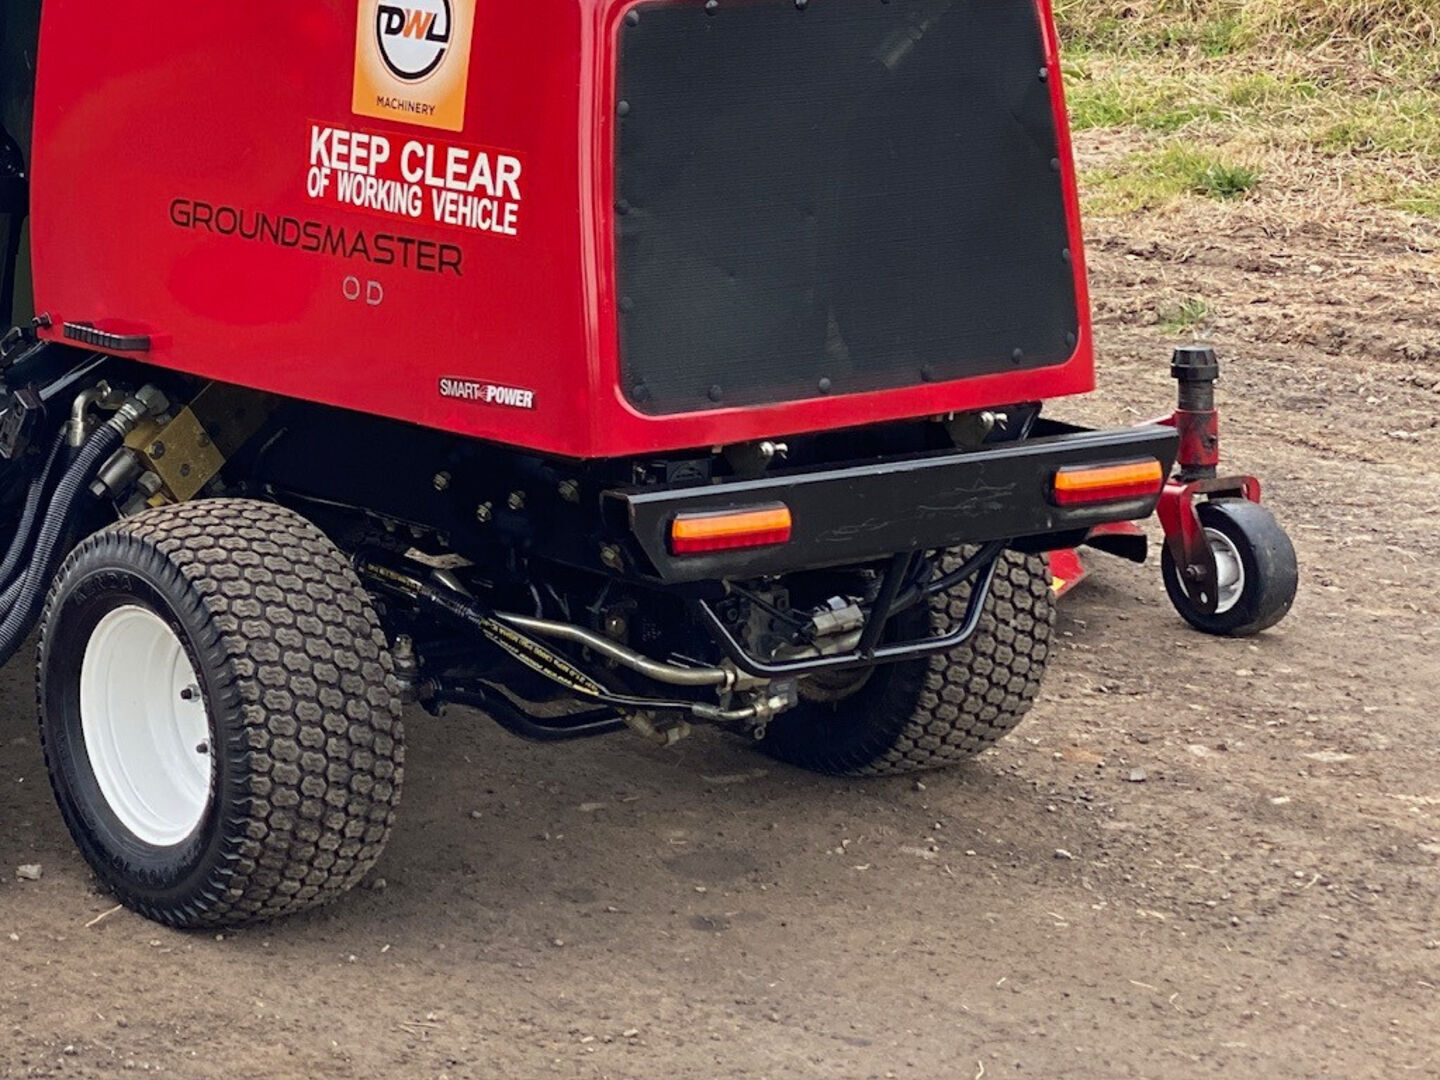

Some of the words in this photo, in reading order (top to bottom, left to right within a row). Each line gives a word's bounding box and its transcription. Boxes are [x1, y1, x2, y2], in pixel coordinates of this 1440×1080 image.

[377, 4, 450, 44] DWL
[376, 95, 436, 116] MACHINERY
[310, 125, 391, 176] KEEP
[400, 140, 522, 201] CLEAR
[307, 166, 331, 198] OF
[337, 171, 422, 218] WORKING
[432, 188, 518, 235] VEHICLE
[169, 198, 463, 276] GROUNDSMASTER
[440, 378, 480, 400] SMART
[485, 384, 534, 409] POWER
